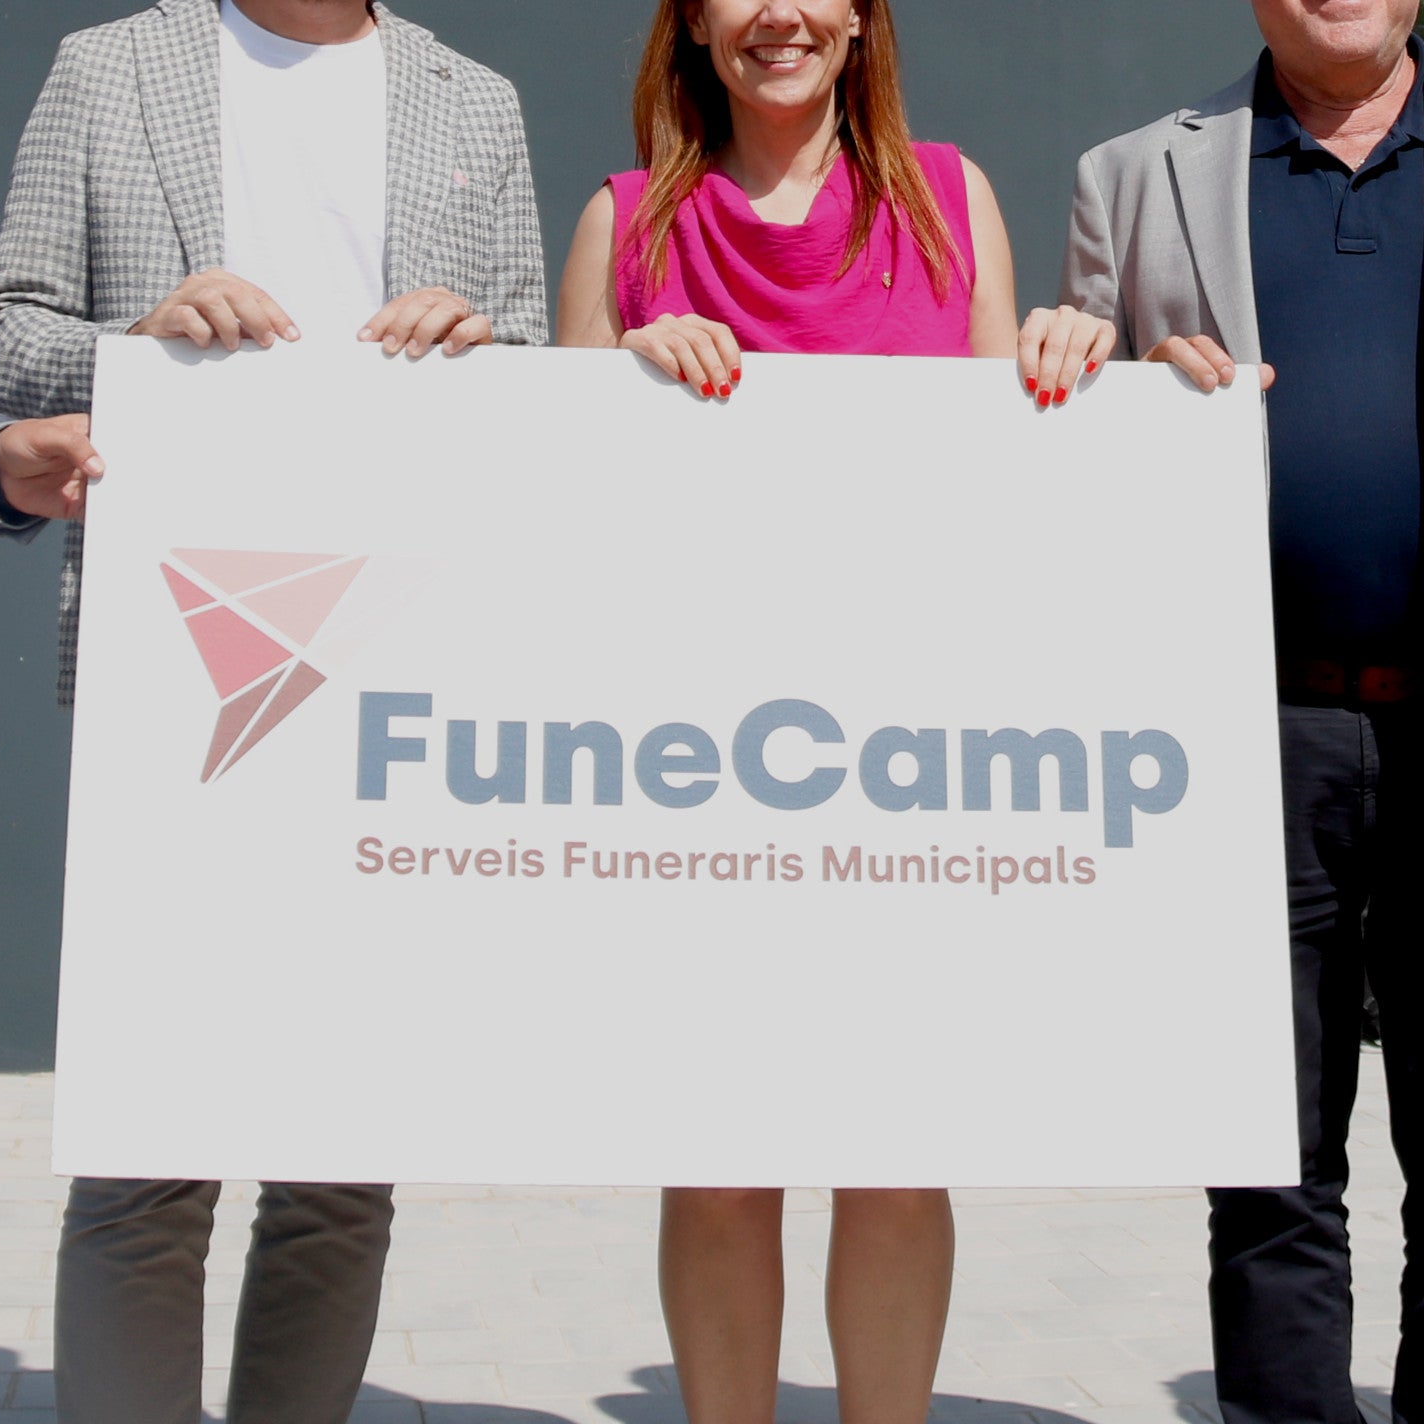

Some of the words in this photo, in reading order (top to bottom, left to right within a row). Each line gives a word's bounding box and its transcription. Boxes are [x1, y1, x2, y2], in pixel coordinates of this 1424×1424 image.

[354, 691, 1190, 849] FuneCamp
[355, 836, 546, 879] Serveis
[563, 841, 805, 882] Funeraris
[822, 845, 1097, 896] Municipals
